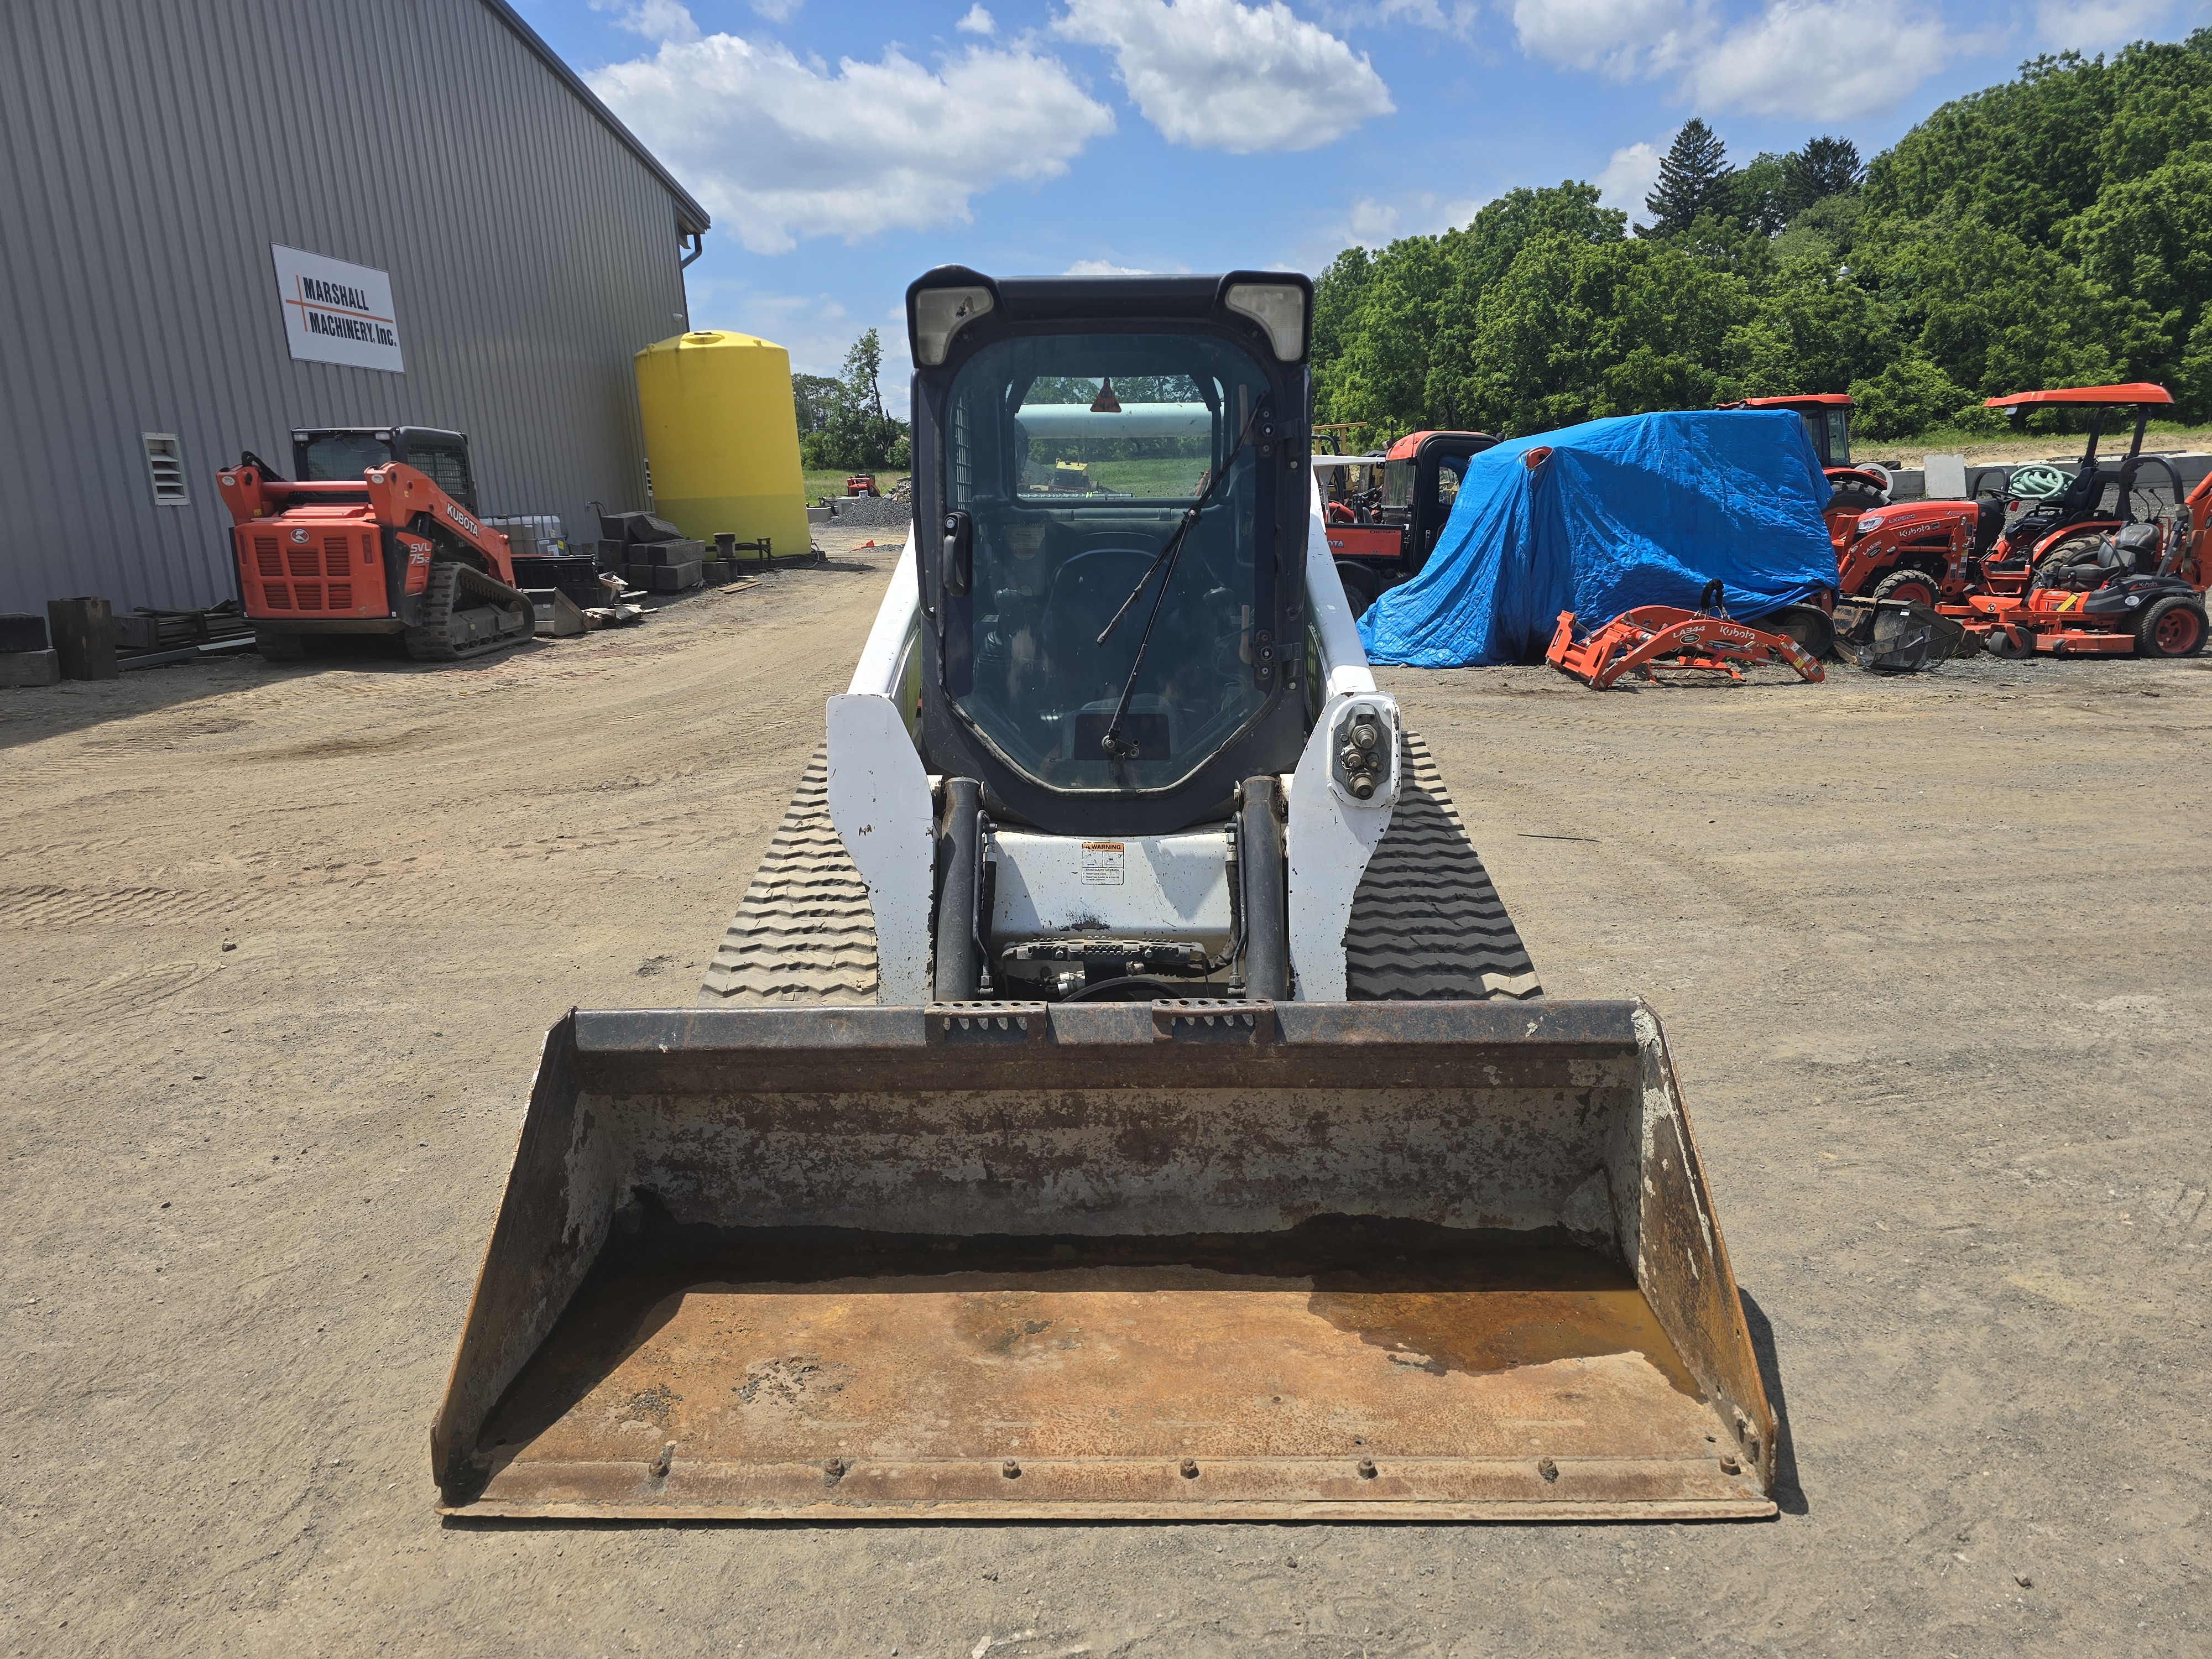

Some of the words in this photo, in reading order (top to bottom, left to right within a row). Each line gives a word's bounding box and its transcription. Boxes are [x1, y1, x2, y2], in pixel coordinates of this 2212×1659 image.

[302, 276, 369, 311] MARSHALL
[309, 311, 375, 345] MACHINERY,
[375, 323, 397, 347] Inc.
[446, 502, 479, 538] KUBOTA
[1899, 524, 1931, 538] Kubota
[410, 542, 431, 553] SVL
[409, 553, 430, 565] 75-2
[1673, 625, 1706, 639] LA344
[1719, 625, 1756, 640] Kubota
